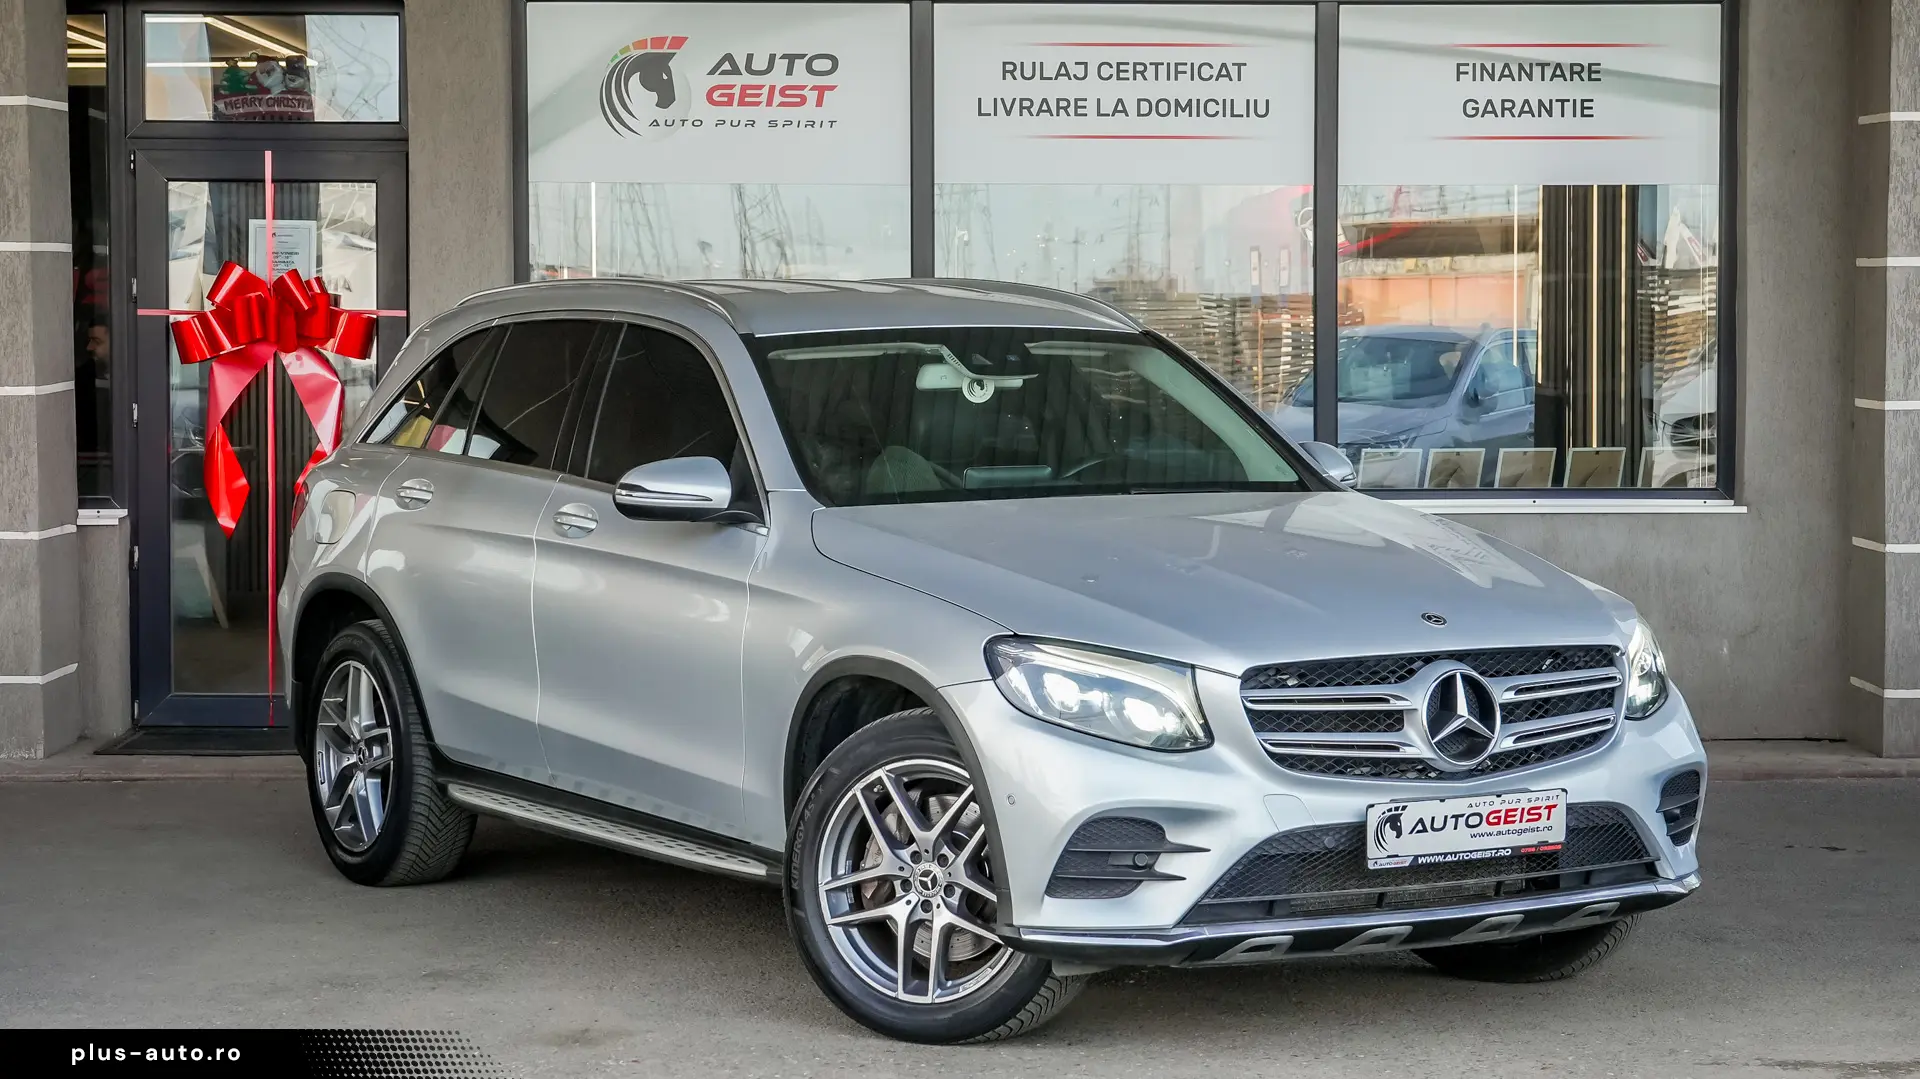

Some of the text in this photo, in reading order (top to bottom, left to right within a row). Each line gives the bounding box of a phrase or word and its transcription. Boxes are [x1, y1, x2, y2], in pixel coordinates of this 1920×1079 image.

[705, 52, 839, 77] AUTO
[1001, 61, 1247, 82] RULAJ CERTIFICAT
[1455, 62, 1602, 82] FINANTARE
[223, 97, 264, 111] MERRY
[705, 84, 839, 108] GEIST
[977, 97, 1271, 119] LIVRARE LA DOMICILIU
[1461, 98, 1595, 119] GARANTIE
[648, 118, 838, 129] AUTO PUR SPIRIT
[1467, 794, 1561, 809] AUTO PUR SPIRIT
[1408, 803, 1559, 835] AUTOGEIST
[1469, 825, 1554, 840] www.autogeist.ro
[790, 820, 806, 890] KINERGY
[1417, 848, 1512, 865] WWW.AUTOGEIST.RO
